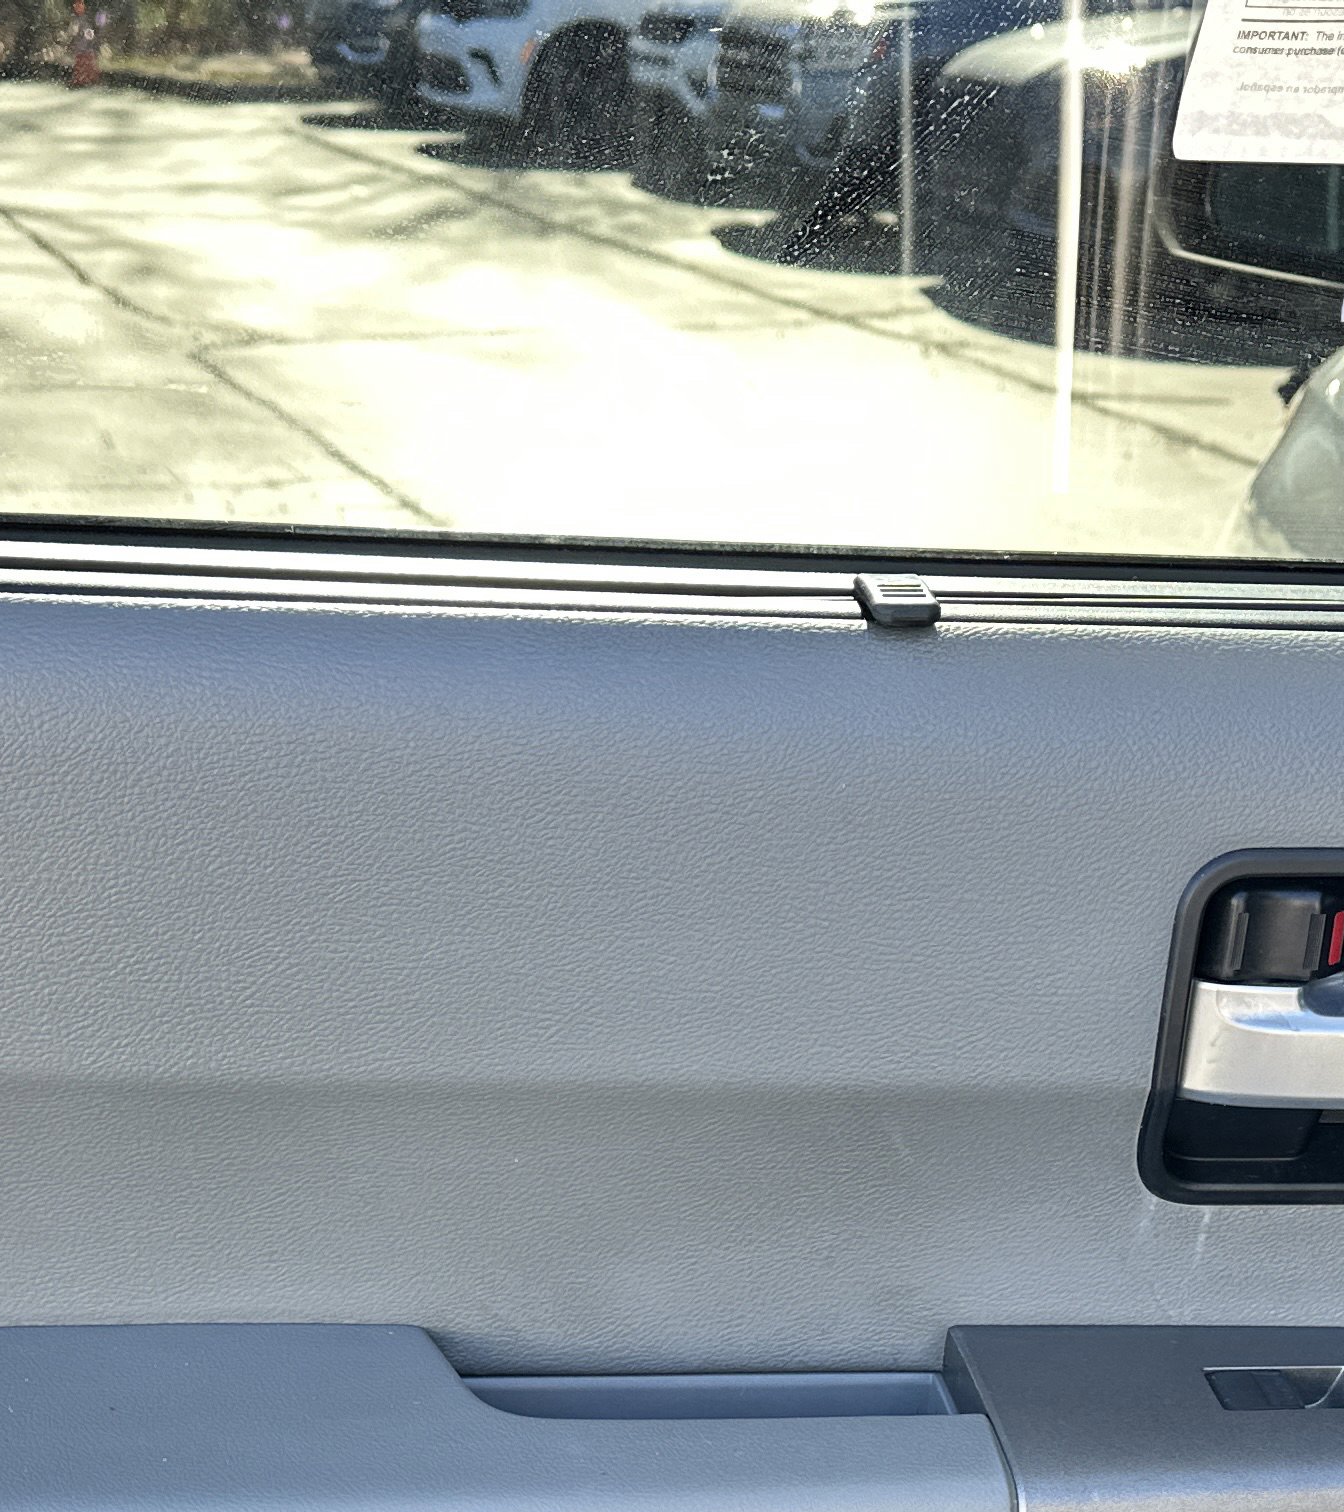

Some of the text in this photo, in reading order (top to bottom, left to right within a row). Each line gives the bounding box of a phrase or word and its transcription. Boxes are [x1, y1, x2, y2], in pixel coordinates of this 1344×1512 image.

[1236, 30, 1310, 42] IMPORTANT:
[1314, 30, 1335, 41] The
[1232, 45, 1285, 56] consumer
[1285, 45, 1337, 57] purchase
